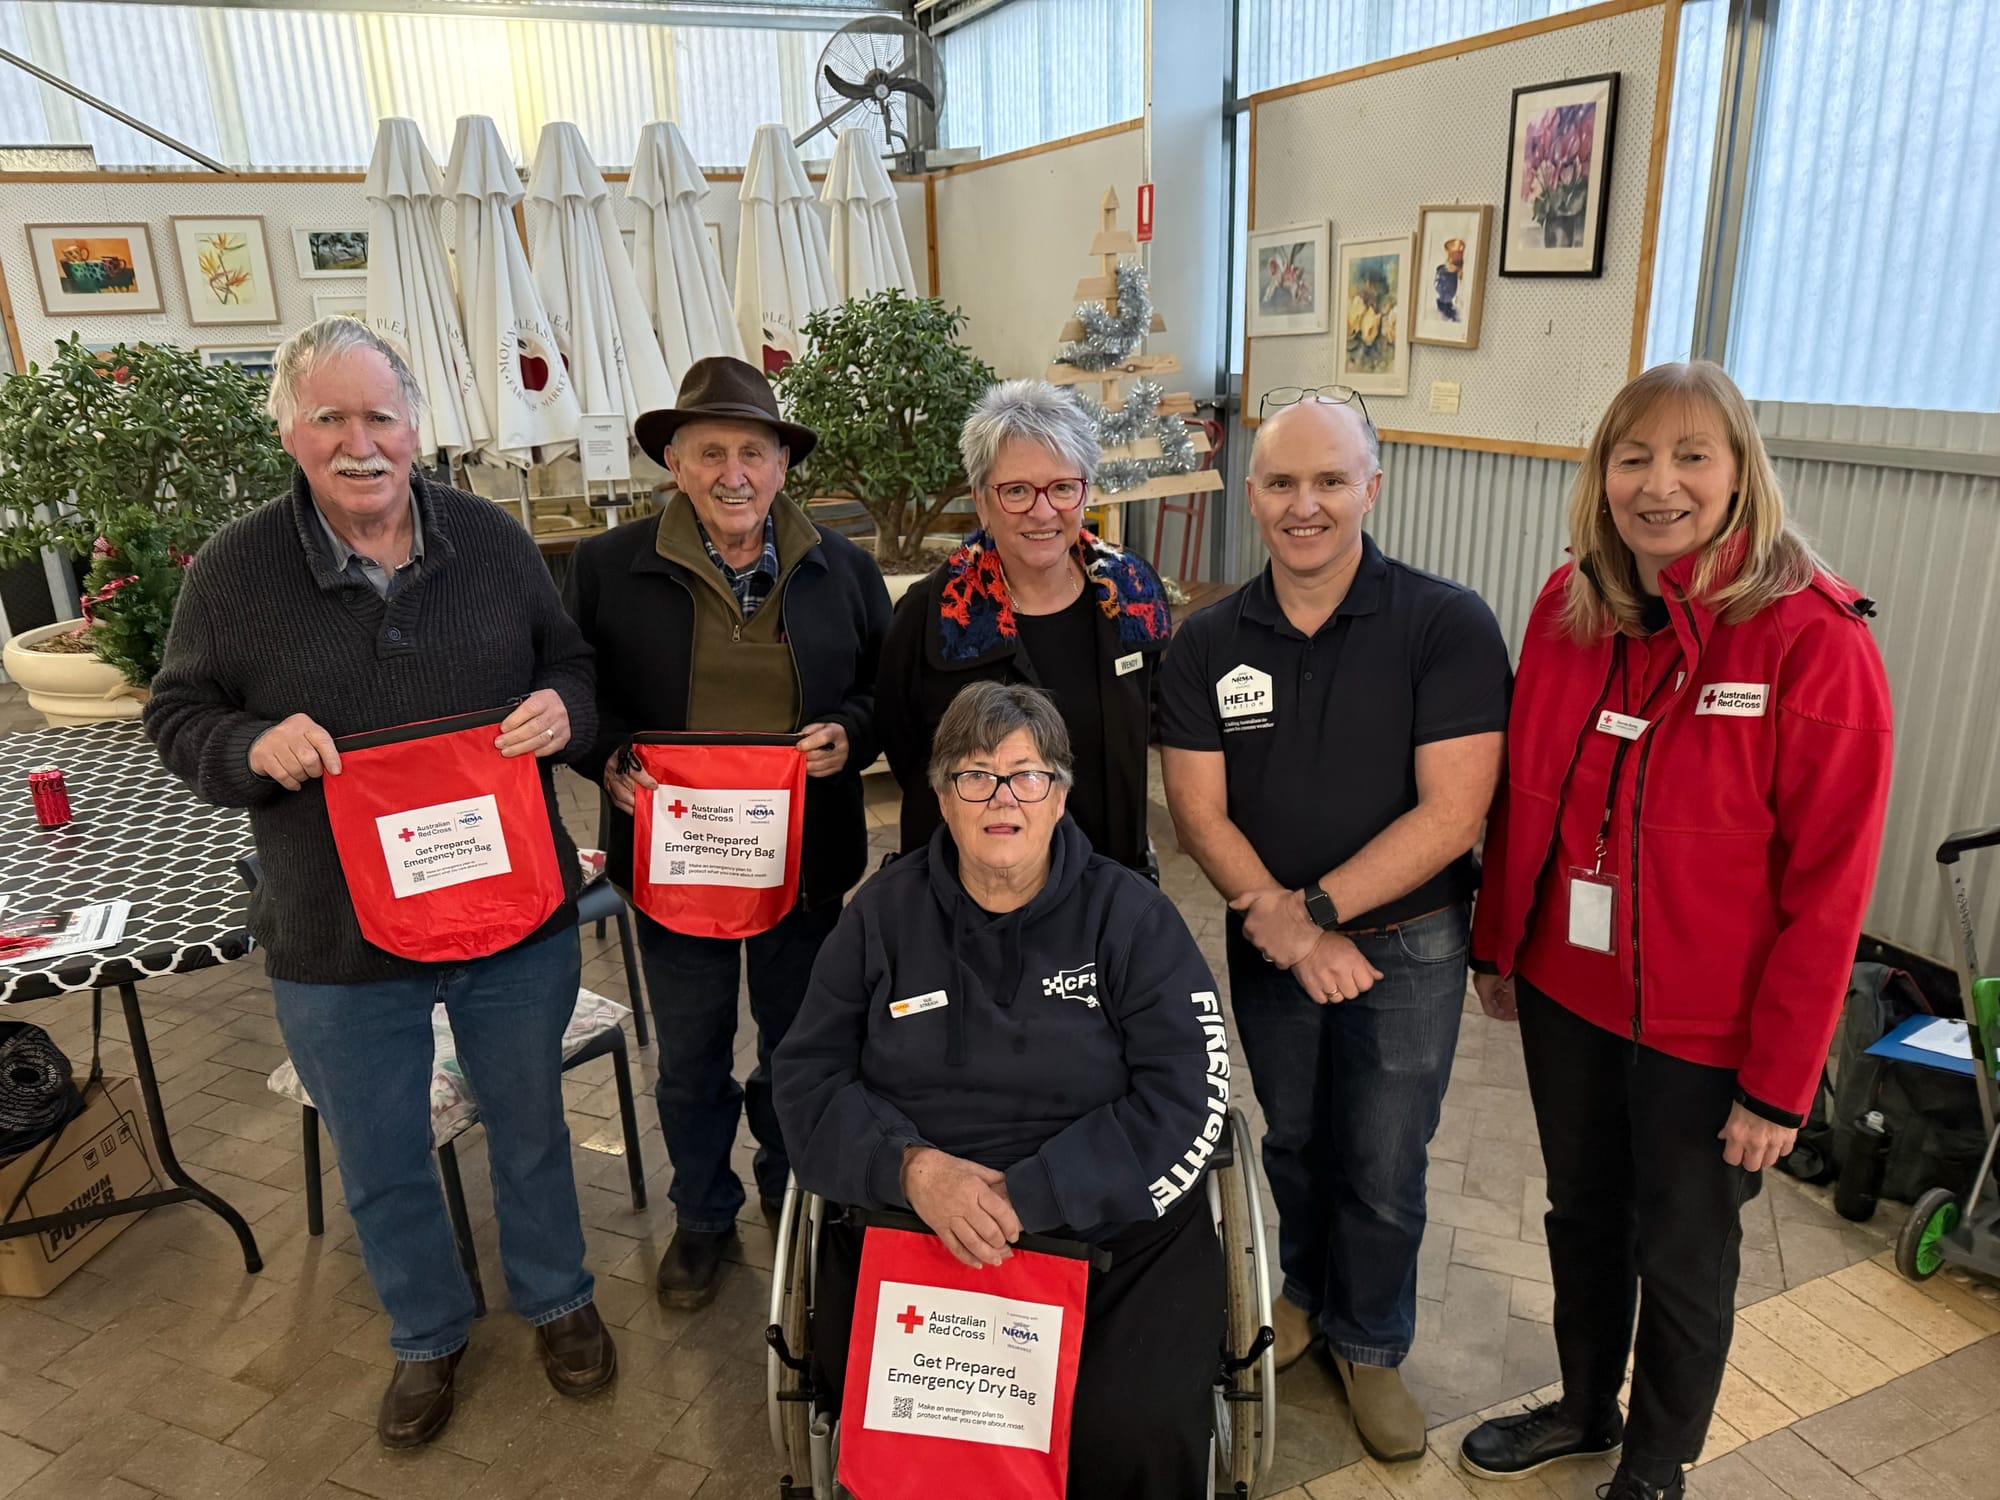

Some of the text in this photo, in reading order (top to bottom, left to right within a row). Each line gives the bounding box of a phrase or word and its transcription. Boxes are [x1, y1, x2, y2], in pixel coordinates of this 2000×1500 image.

[1231, 675, 1254, 684] NRMA
[1223, 690, 1265, 706] HELP
[1718, 691, 1762, 700] Australian
[1225, 701, 1264, 710] NATION
[1717, 699, 1760, 709] Red Cross
[691, 803, 734, 814] Australian
[691, 811, 734, 822] Red Cross
[745, 808, 775, 816] NRMA
[416, 820, 451, 832] Australian
[432, 826, 452, 836] Cross
[415, 837, 476, 856] Get Prepared
[683, 831, 759, 846] Get Prepared
[403, 843, 492, 868] Emergency Dry Bag
[665, 842, 775, 859] Emergency Dry Bag
[1064, 972, 1096, 991] CFS
[929, 1311, 987, 1328] Australian
[928, 1323, 986, 1340] Red Cross
[1002, 1326, 1039, 1342] NRMA
[913, 1353, 1016, 1379] Get Prepared
[887, 1368, 1037, 1406] Emergency Dry Bag
[918, 1402, 935, 1411] Make
[945, 1406, 981, 1417] emergency
[982, 1410, 996, 1418] plan
[916, 1411, 941, 1420] protect
[942, 1414, 958, 1422] what
[959, 1417, 971, 1425] you
[972, 1418, 987, 1426] care
[987, 1420, 1006, 1428] about
